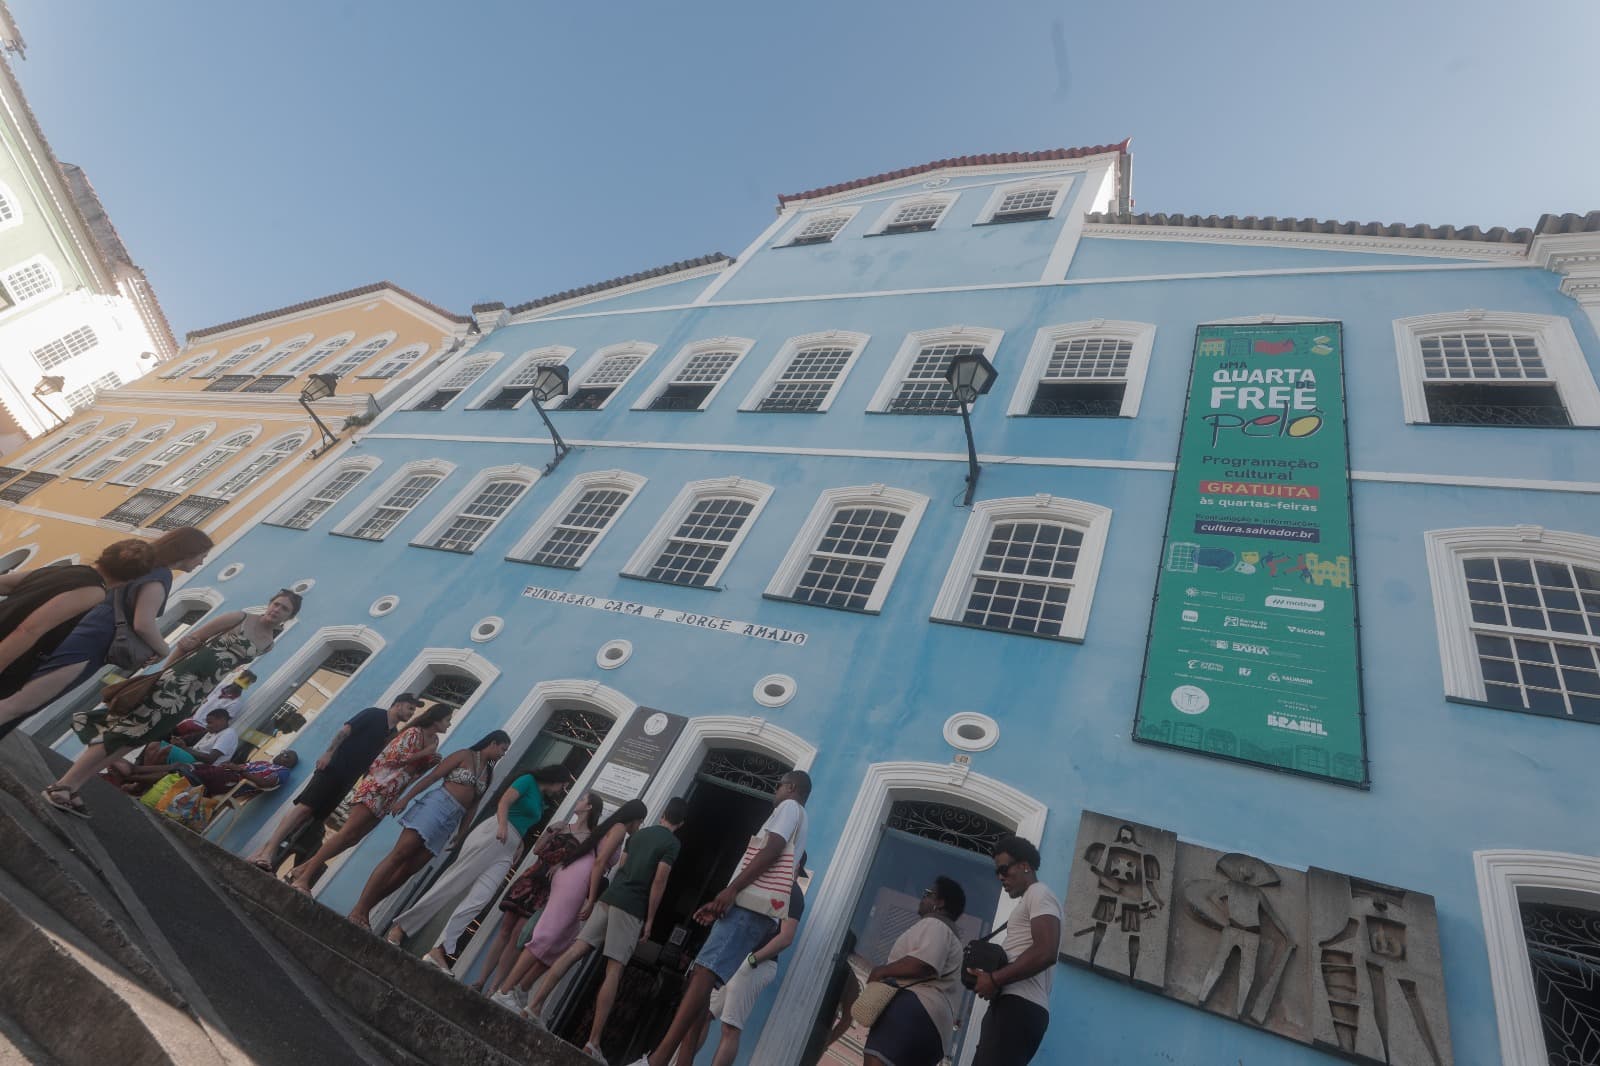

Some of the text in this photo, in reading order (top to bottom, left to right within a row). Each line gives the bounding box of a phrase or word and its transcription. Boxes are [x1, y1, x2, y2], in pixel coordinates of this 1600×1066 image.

[1220, 361, 1248, 369] UMA
[1213, 368, 1316, 384] QUARTA
[1296, 381, 1315, 389] DE
[1210, 386, 1317, 410] FREE
[1202, 455, 1319, 469] Programação
[1224, 469, 1293, 480] cultural
[1207, 482, 1311, 498] GRATUITA
[1200, 496, 1318, 512] às quartas-feiras
[1201, 524, 1315, 539] cultura.salvador.br
[675, 612, 732, 631] JORGE
[743, 624, 806, 645] AMADO
